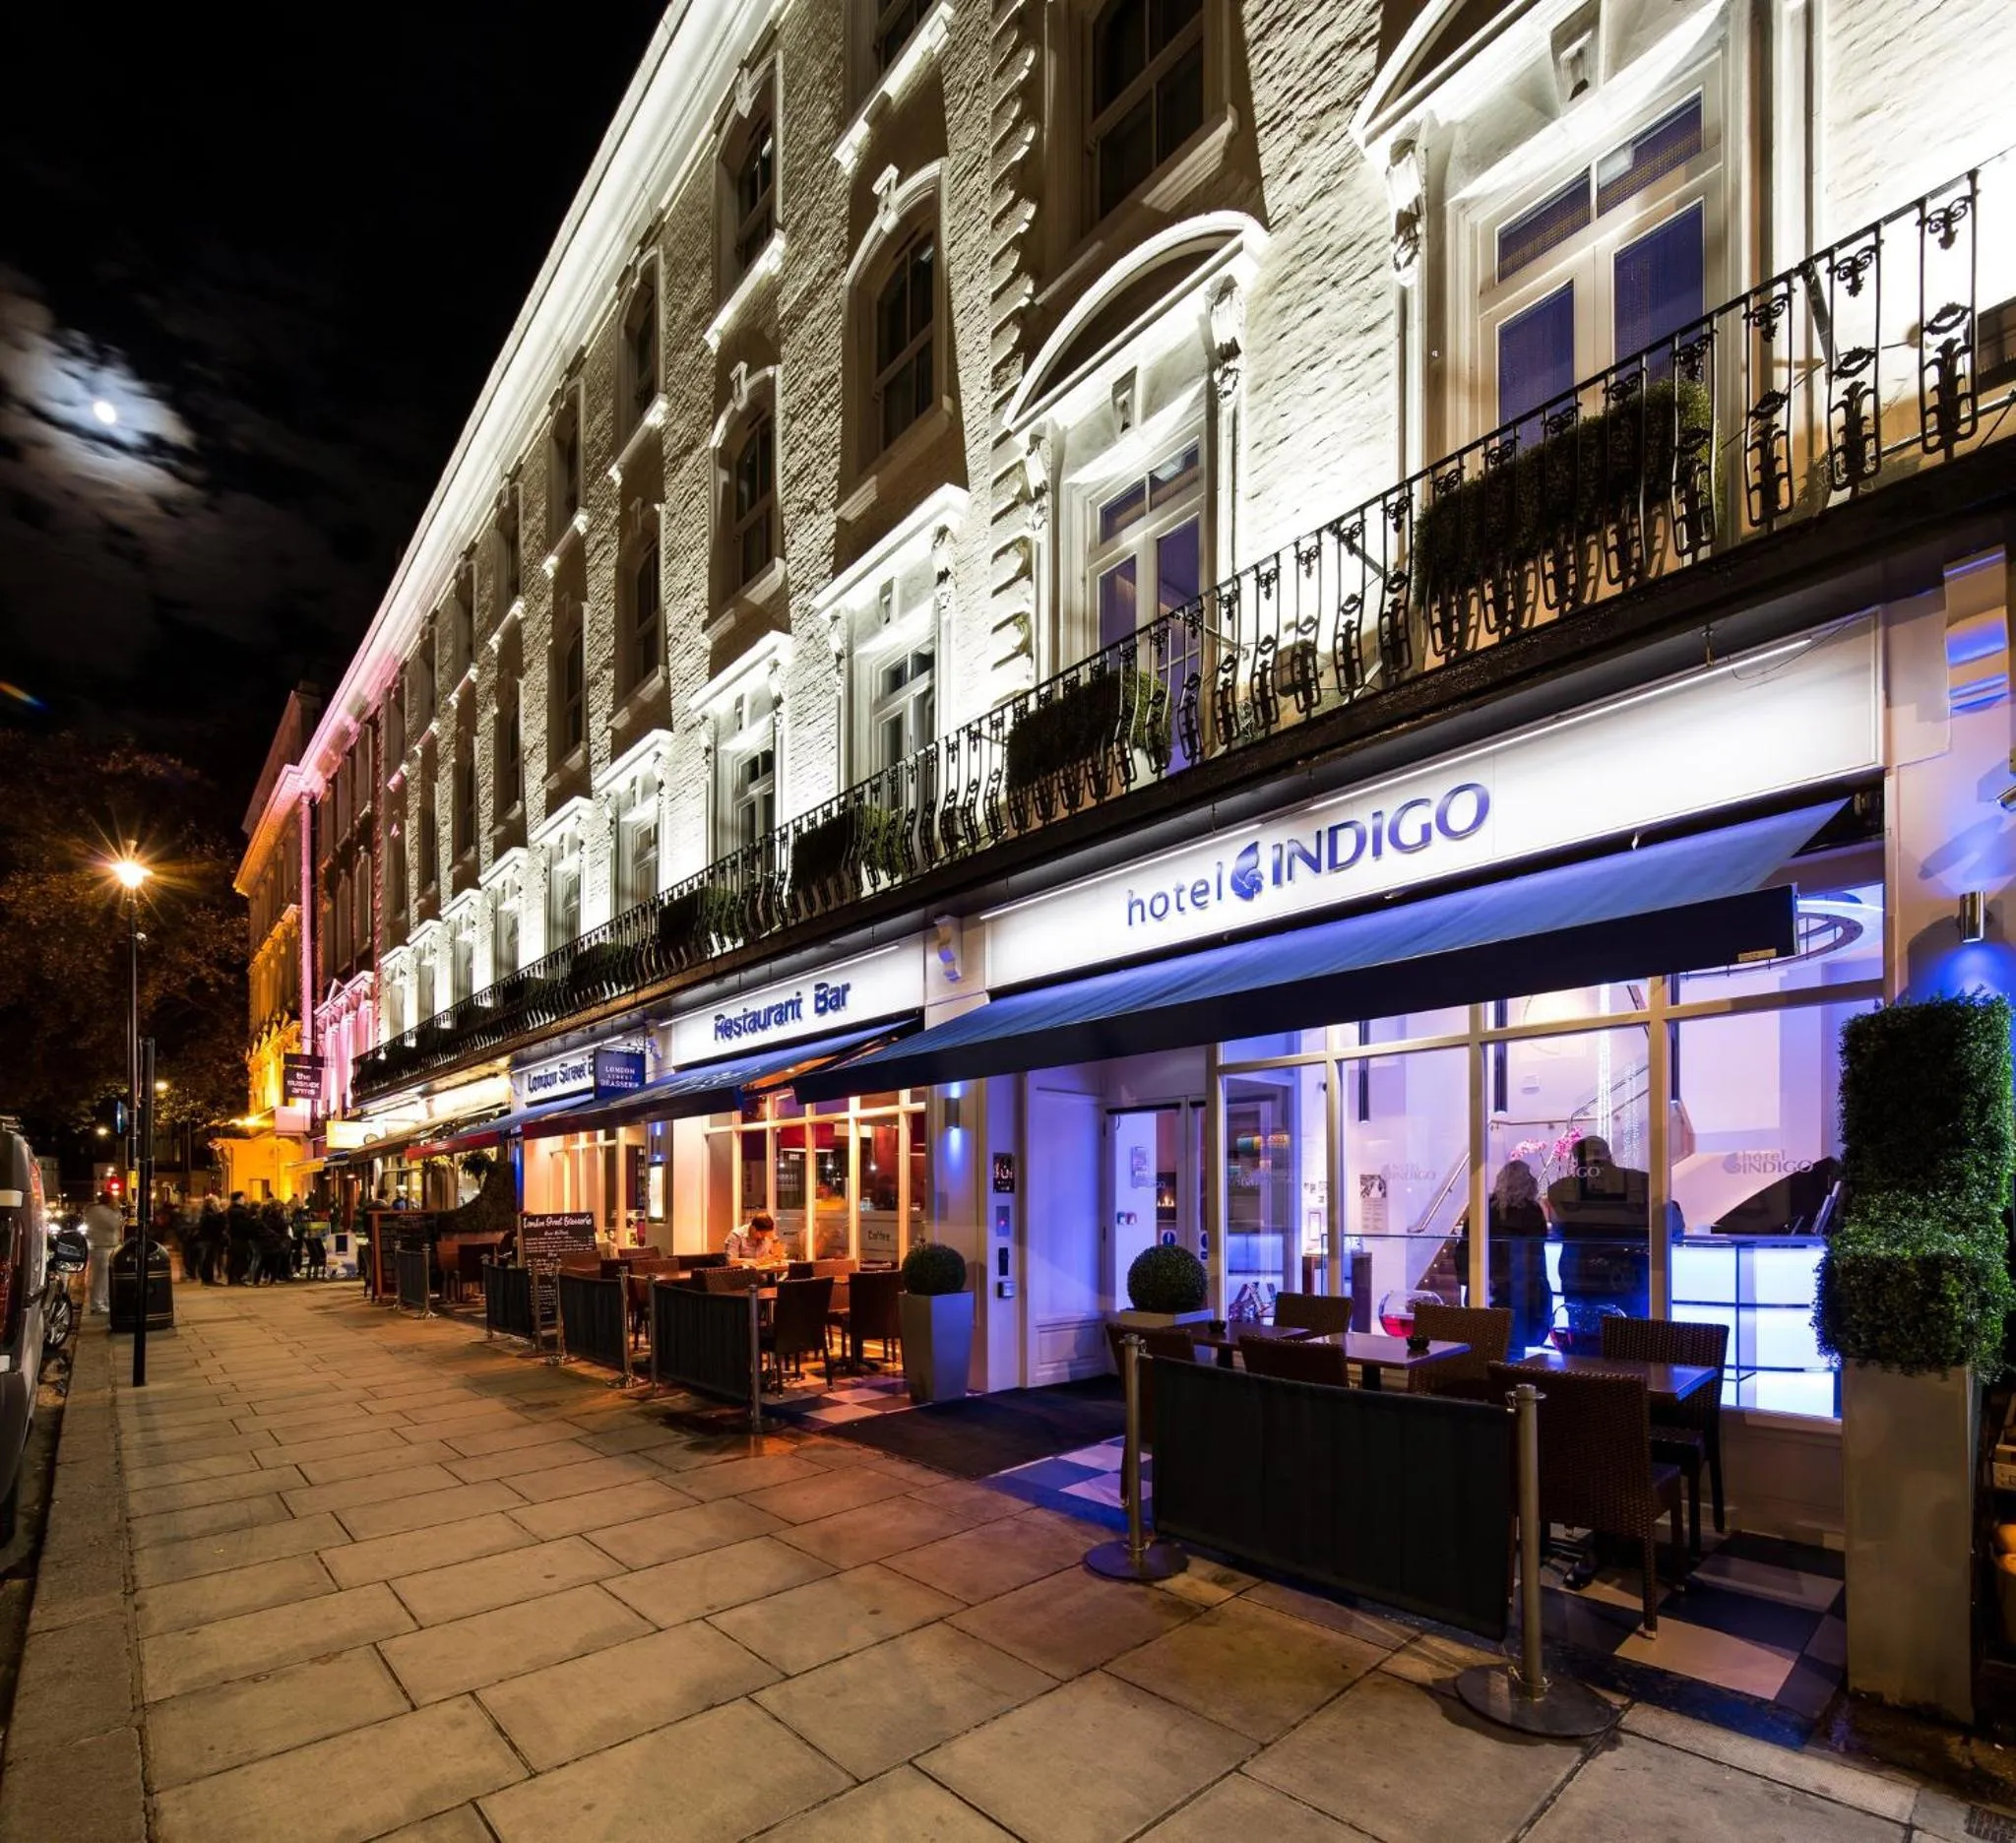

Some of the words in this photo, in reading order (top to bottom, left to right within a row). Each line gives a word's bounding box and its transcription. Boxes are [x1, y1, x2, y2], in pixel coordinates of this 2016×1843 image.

[1127, 860, 1224, 927] hotel
[1271, 782, 1491, 889] INDIGO
[714, 990, 803, 1043] Restaurant
[814, 982, 850, 1018] Bar
[528, 1068, 557, 1093] London
[558, 1057, 588, 1084] Street
[605, 1064, 636, 1075] LONDON
[1742, 1149, 1786, 1162] hotel
[1742, 1160, 1813, 1175] INDIGO
